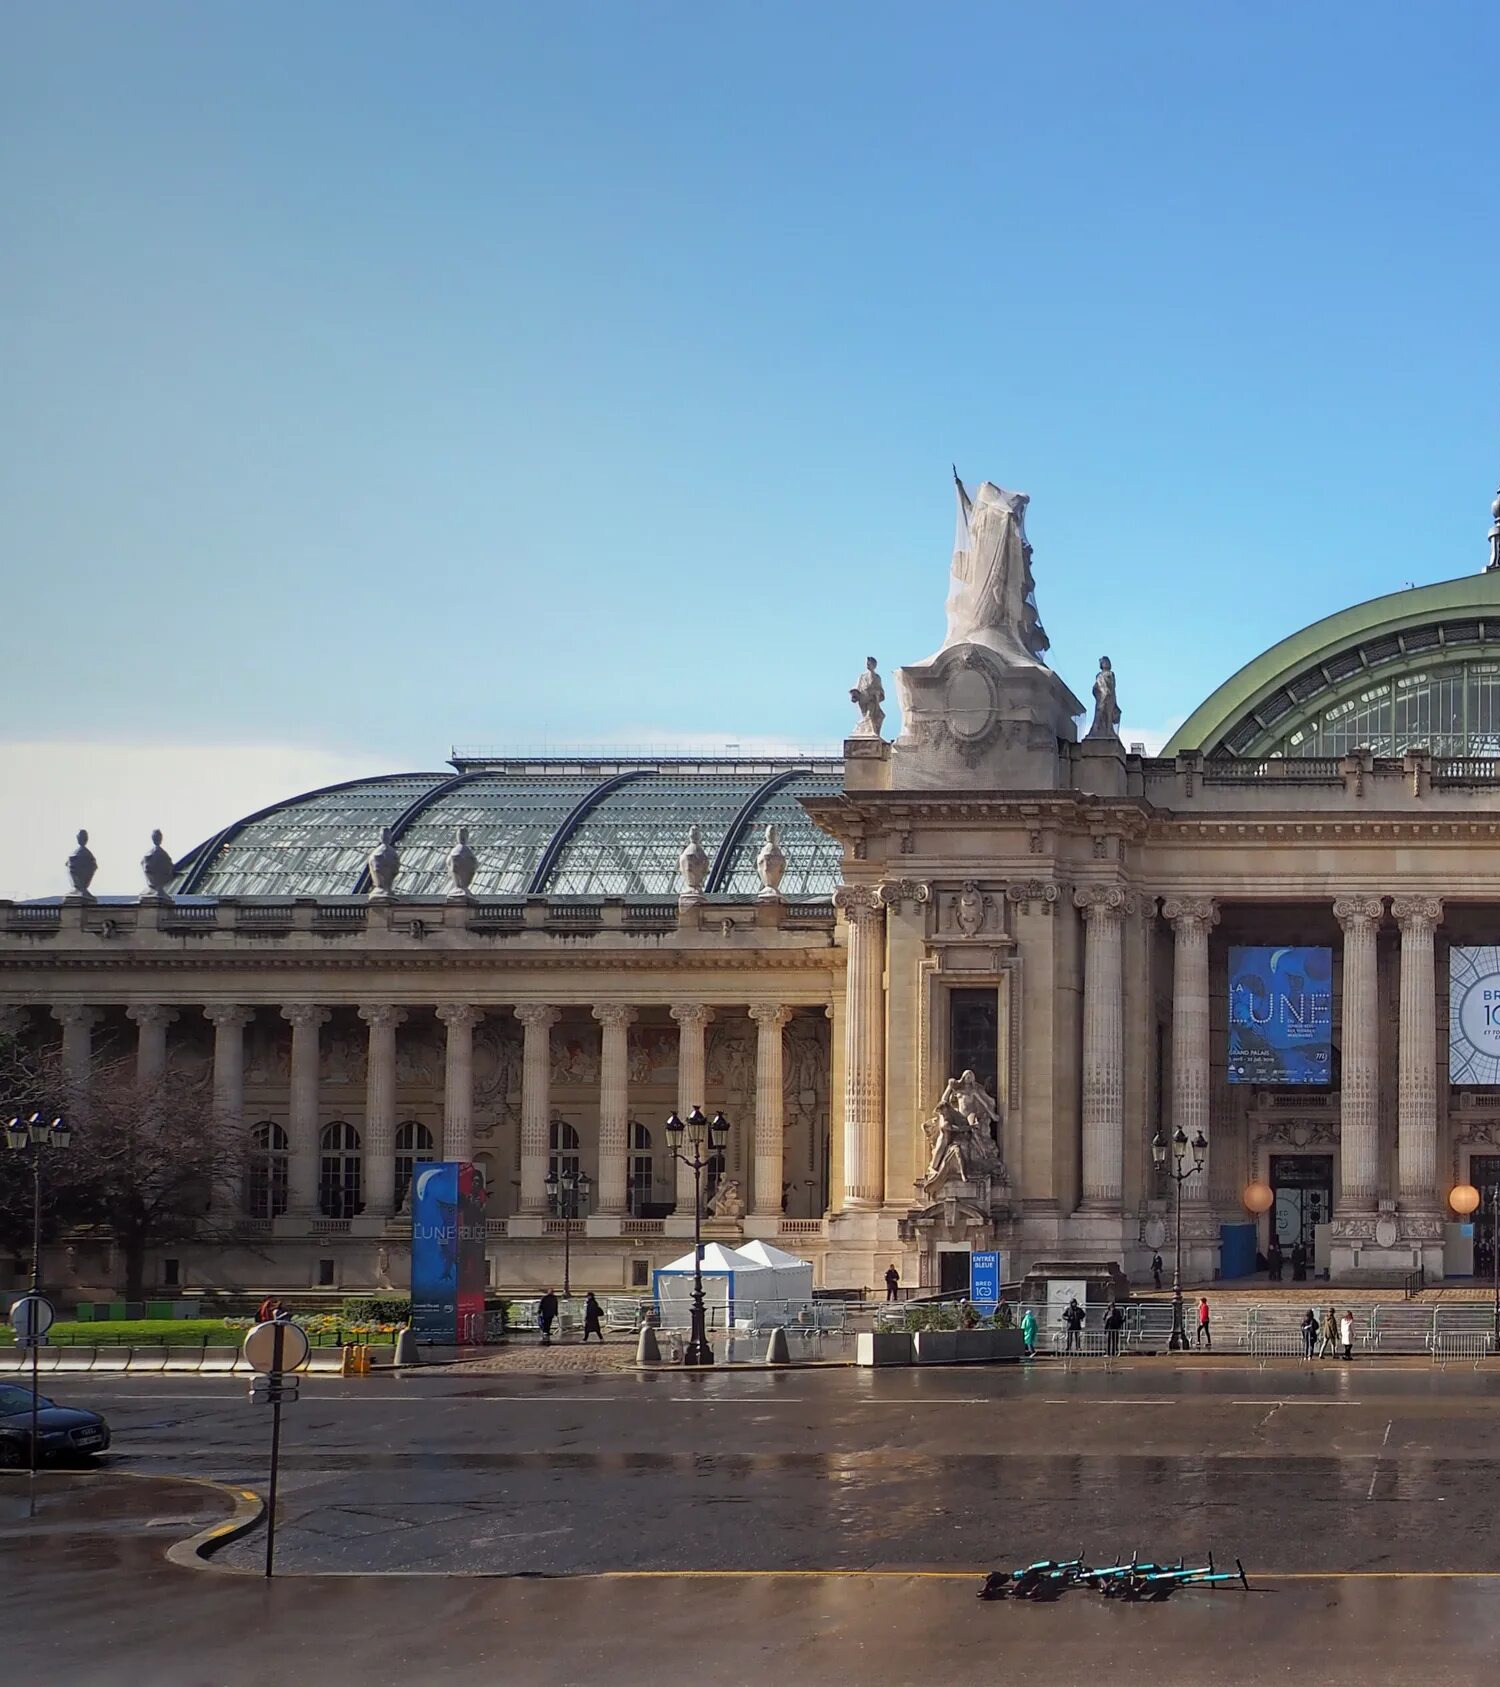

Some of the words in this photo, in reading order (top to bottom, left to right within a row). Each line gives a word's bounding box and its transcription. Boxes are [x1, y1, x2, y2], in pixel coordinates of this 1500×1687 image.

[1229, 984, 1244, 992] LA
[1229, 993, 1330, 1024] LUNE
[414, 1226, 457, 1239] LUNE
